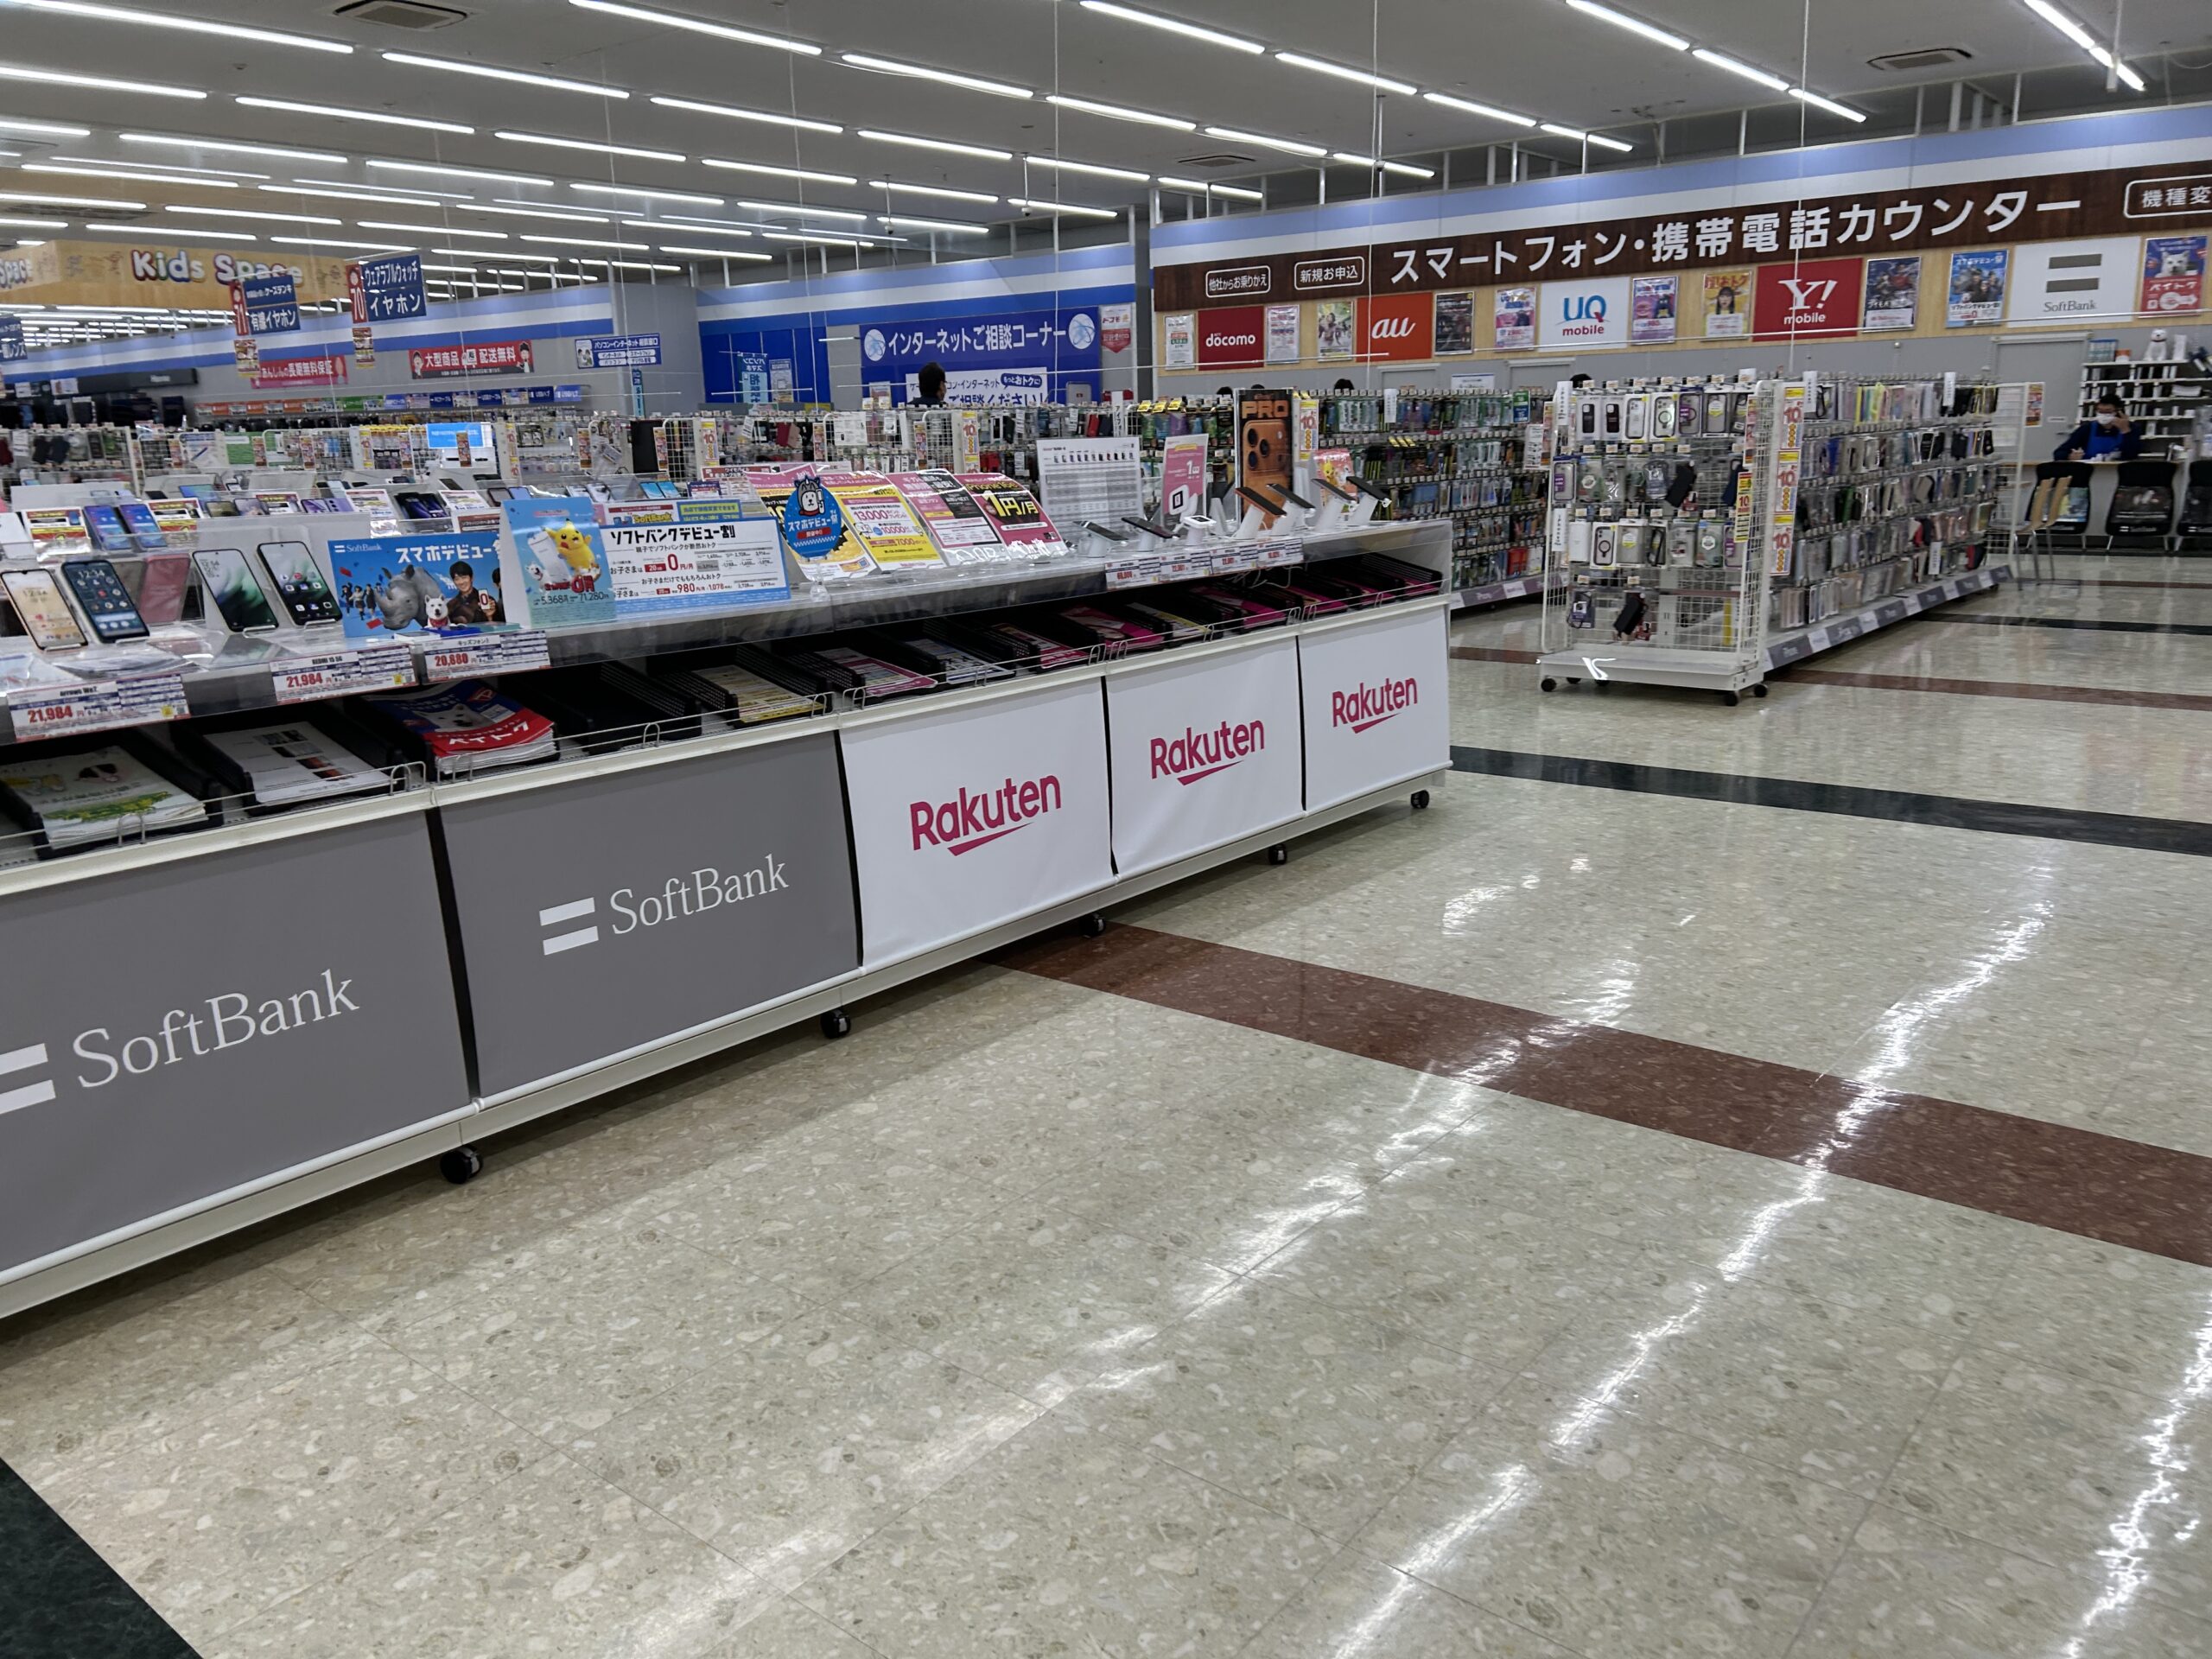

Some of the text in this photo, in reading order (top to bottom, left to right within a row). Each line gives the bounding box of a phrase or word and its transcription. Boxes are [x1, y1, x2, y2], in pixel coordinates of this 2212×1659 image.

[1391, 191, 2081, 283] スマートフォン・携帯電話カウンター
[131, 249, 207, 283] Kids
[365, 260, 418, 288] ウェアラブルウォッチ
[1300, 265, 1358, 283] 新規お申込
[1209, 274, 1268, 291] 他社からお乗りかえ
[1777, 279, 1838, 310] Y!
[370, 294, 422, 317] イヤホン
[1564, 295, 1607, 323] UQ
[2043, 300, 2096, 313] SoftBank
[1371, 317, 1416, 340] au
[1783, 312, 1826, 325] mobile
[888, 321, 1066, 356] インターネットご相談コーナー
[1205, 333, 1256, 347] docomo
[1562, 324, 1605, 336] mobile
[425, 346, 516, 368] 大型商品 配送無料
[1242, 400, 1288, 419] PRO
[787, 513, 838, 532] スマホデビュー祭
[611, 524, 736, 545] ソフトバンクデビュー割
[346, 543, 383, 553] SoftBank
[610, 566, 644, 575] お子さまは
[667, 553, 679, 571] 0
[677, 582, 696, 593] 980
[480, 593, 489, 606] 0
[435, 652, 469, 667] 20,880
[286, 672, 323, 689] 21,984
[1332, 677, 1418, 728] Rakuten
[28, 705, 73, 723] 21,984
[1151, 720, 1265, 779] Rakuten
[910, 775, 1061, 851] Rakuten
[608, 853, 789, 938] SoftBank
[72, 968, 360, 1090] SoftBank
